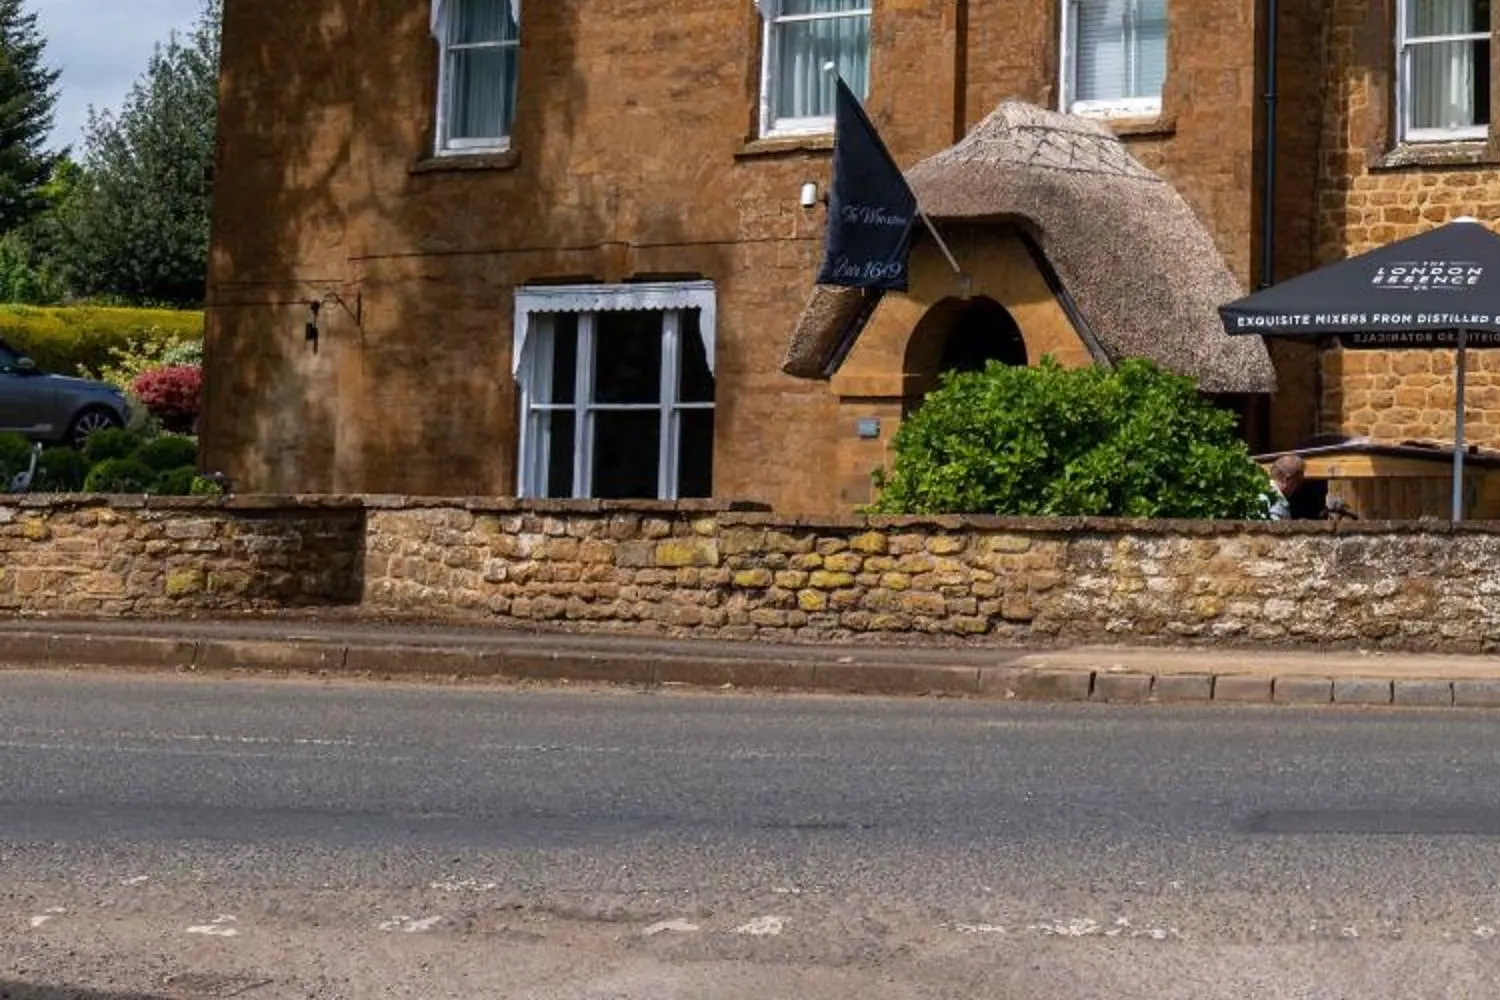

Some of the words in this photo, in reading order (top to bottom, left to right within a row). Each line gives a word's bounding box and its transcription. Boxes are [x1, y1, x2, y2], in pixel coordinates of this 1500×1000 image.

[1377, 267, 1482, 275] LONDON
[1372, 275, 1478, 285] ESSENCE
[1237, 314, 1311, 327] EXQUISITE
[1315, 313, 1367, 325] MIXERS
[1372, 313, 1412, 324] FROM
[1417, 313, 1489, 324] DISTILLED
